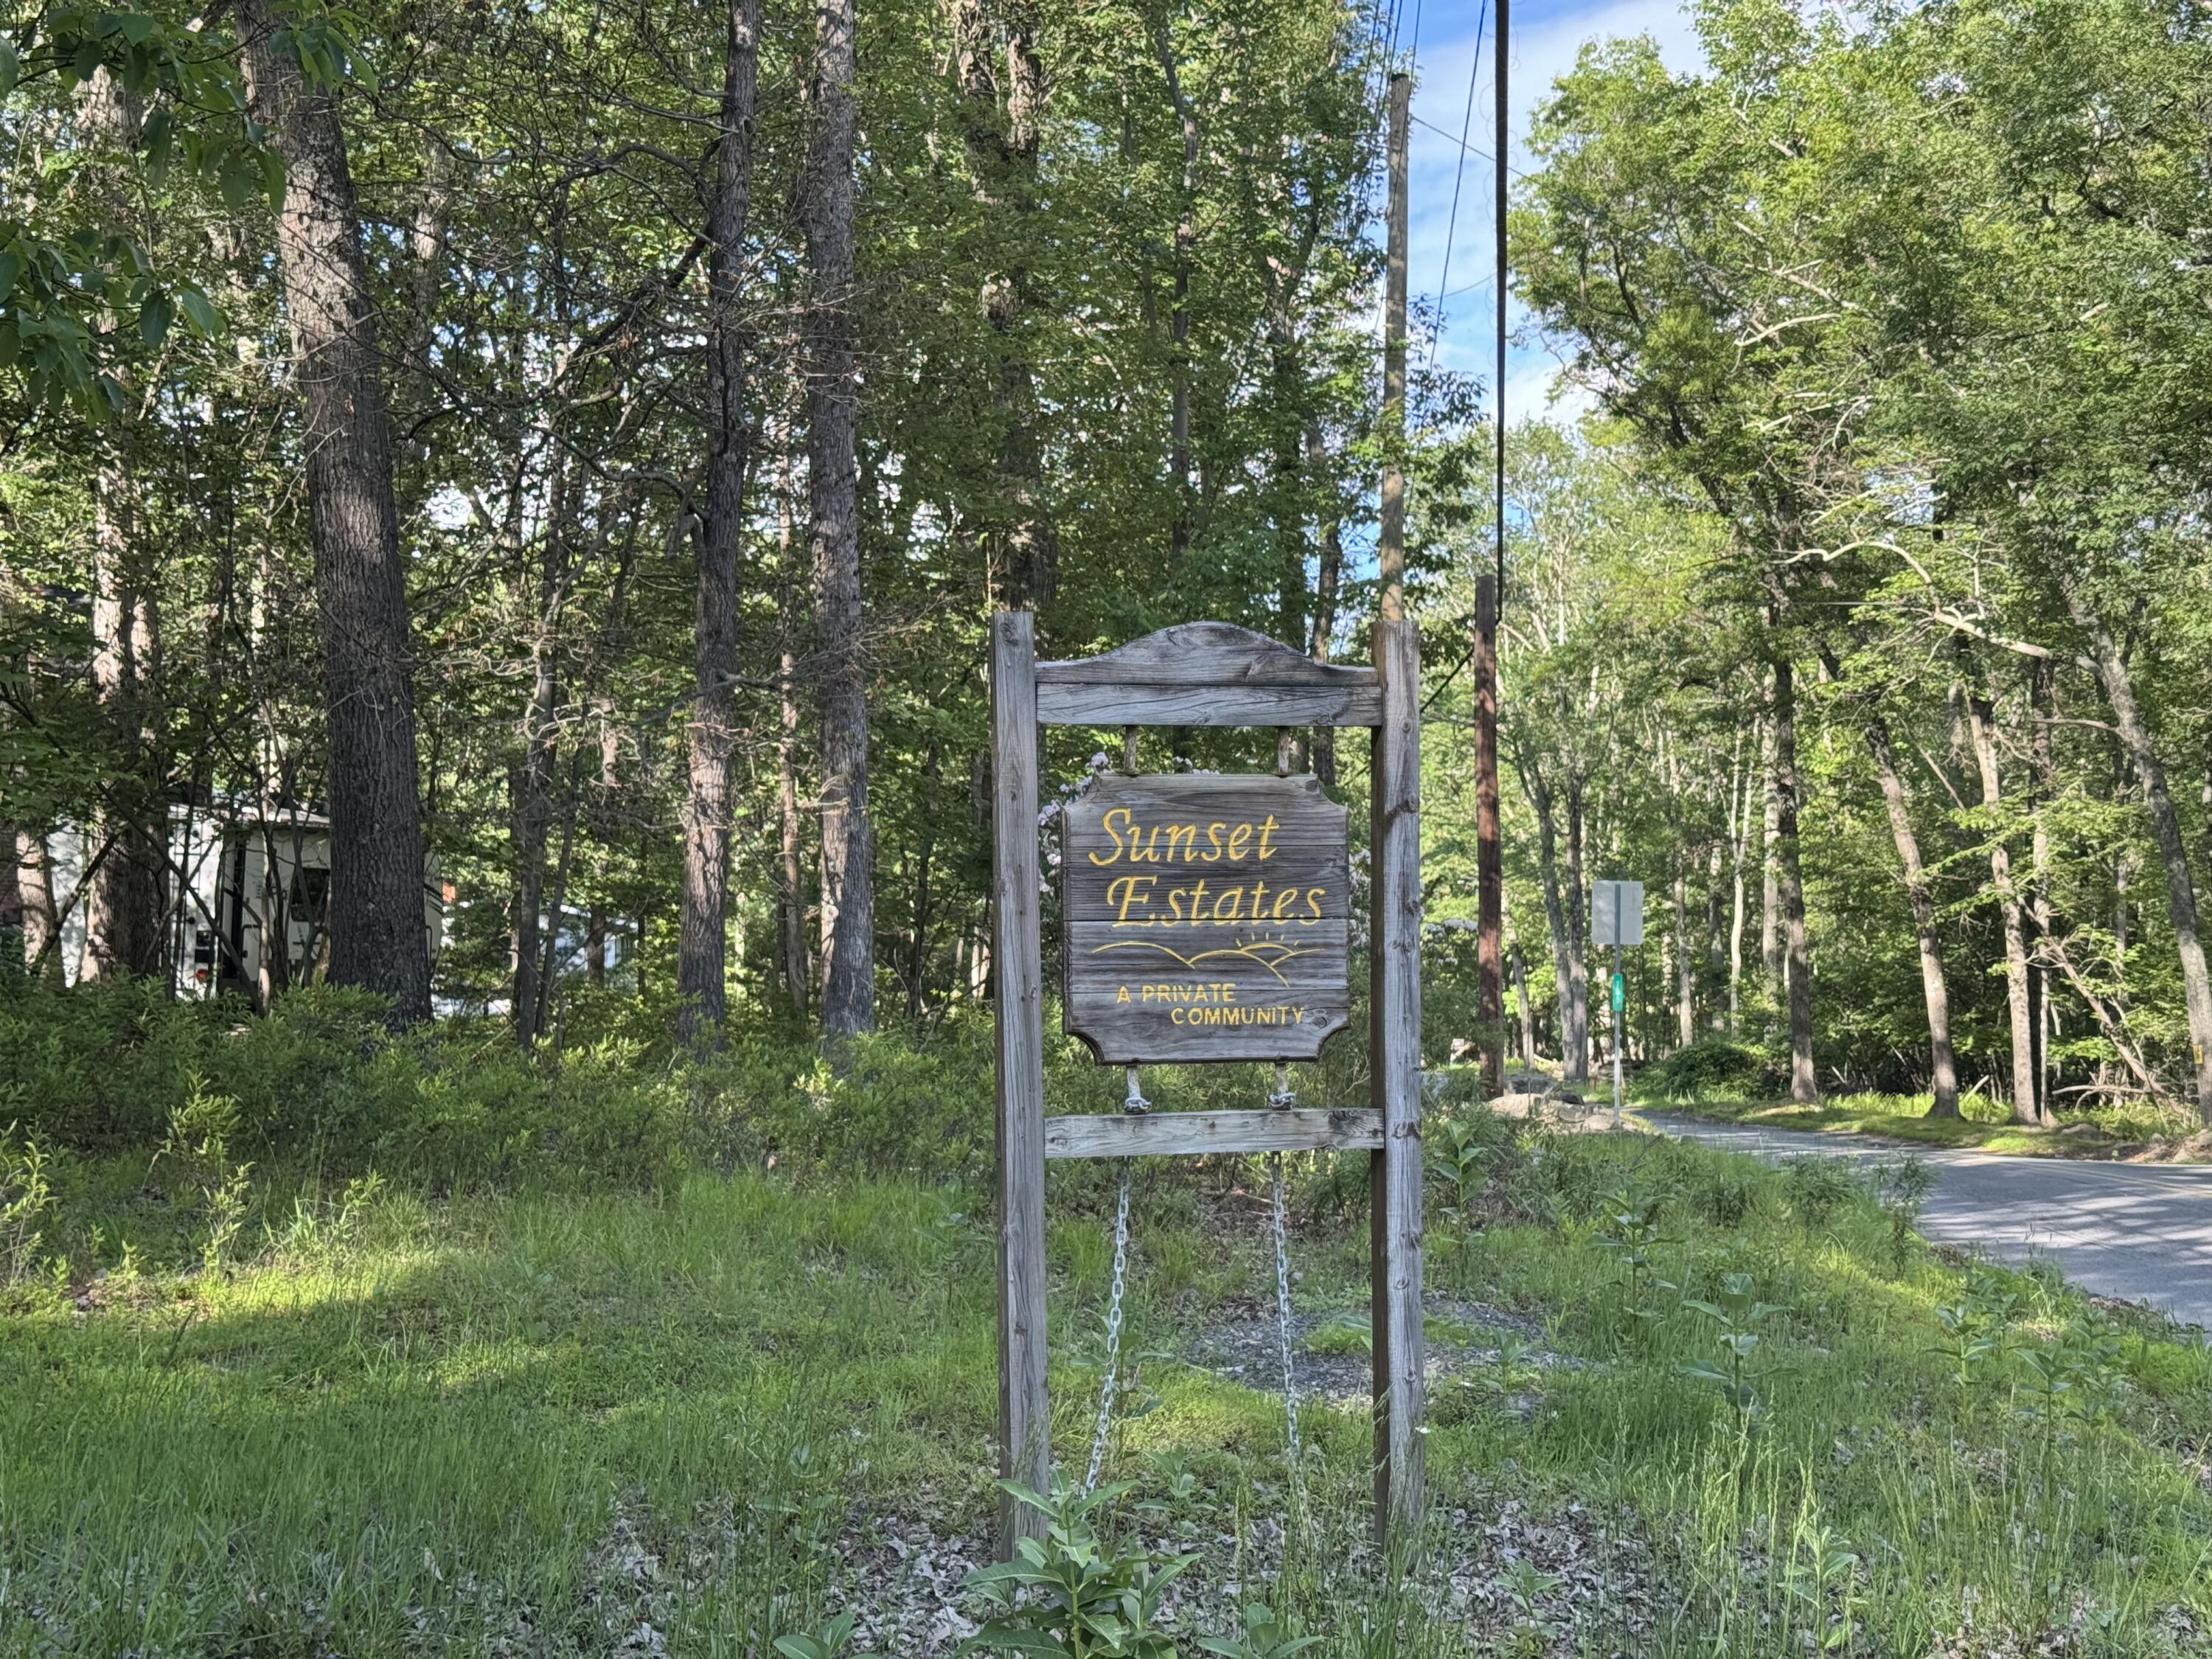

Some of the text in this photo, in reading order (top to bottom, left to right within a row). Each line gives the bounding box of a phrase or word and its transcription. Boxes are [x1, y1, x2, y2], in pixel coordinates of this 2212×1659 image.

[1088, 807, 1279, 866] Sunset
[1107, 875, 1326, 928] Estates
[1116, 983, 1237, 1004] A PRIVATE
[1171, 1006, 1304, 1025] COMMUNITY
